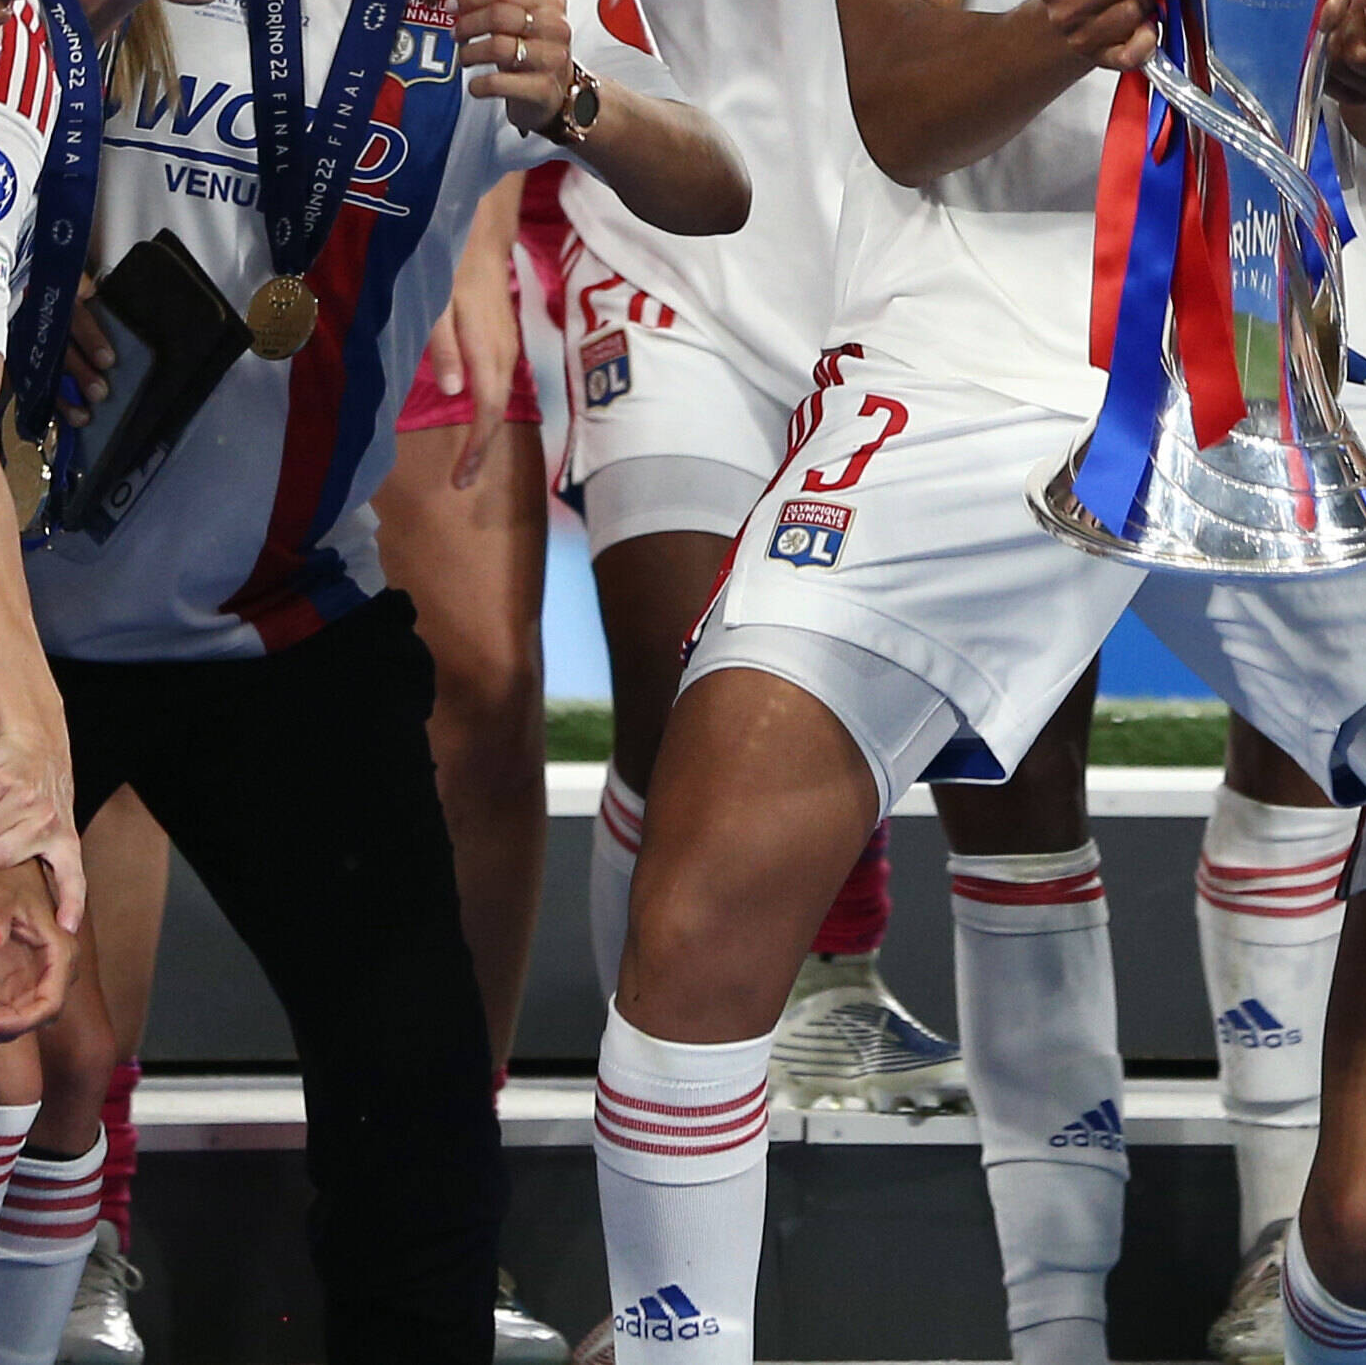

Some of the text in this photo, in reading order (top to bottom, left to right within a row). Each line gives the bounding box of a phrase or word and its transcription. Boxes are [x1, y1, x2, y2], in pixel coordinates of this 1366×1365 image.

[406, 8, 455, 26] NNAIS
[270, 58, 288, 81] 22
[389, 28, 446, 73] OL
[51, 1, 85, 180] TORINO 22 FINAL
[272, 93, 290, 174] FINAL
[316, 157, 337, 180] 22
[328, 68, 365, 146] FINAL
[164, 164, 258, 208] VENU
[801, 394, 909, 493] 3
[784, 511, 845, 529] LYONNAIS
[786, 503, 847, 519] OLYMPIQUE
[777, 528, 834, 562] OL
[614, 1312, 720, 1342] adidas
